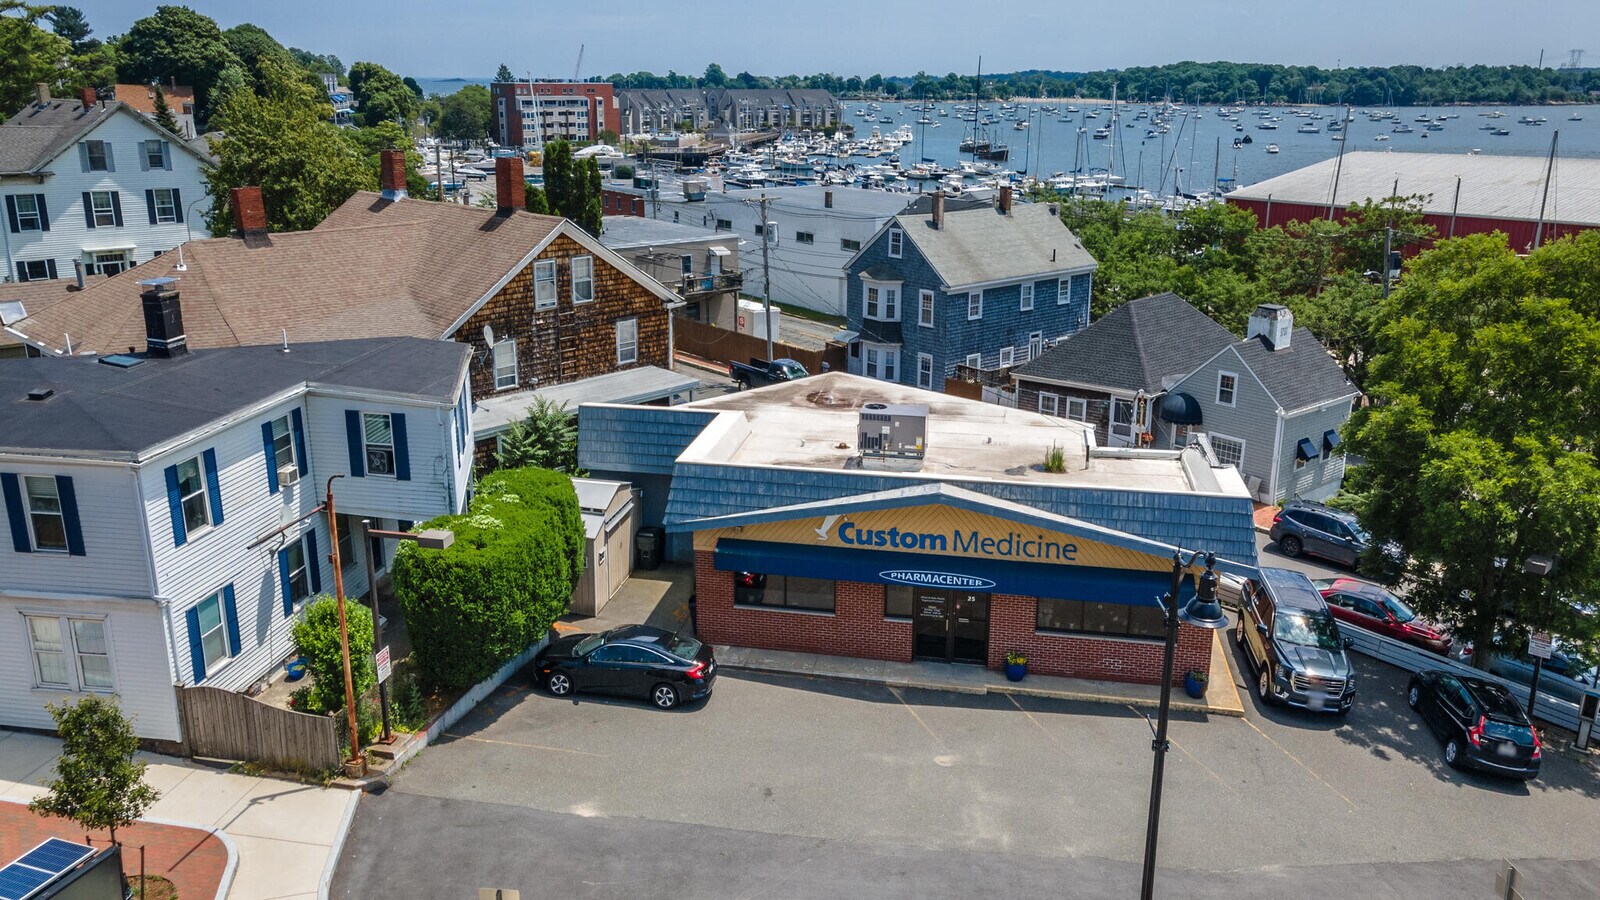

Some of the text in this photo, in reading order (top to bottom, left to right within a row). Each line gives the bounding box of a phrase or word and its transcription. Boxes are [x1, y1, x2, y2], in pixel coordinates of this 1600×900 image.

[838, 522, 1078, 561] Custom Medicine
[890, 572, 983, 587] PHARMACENTER
